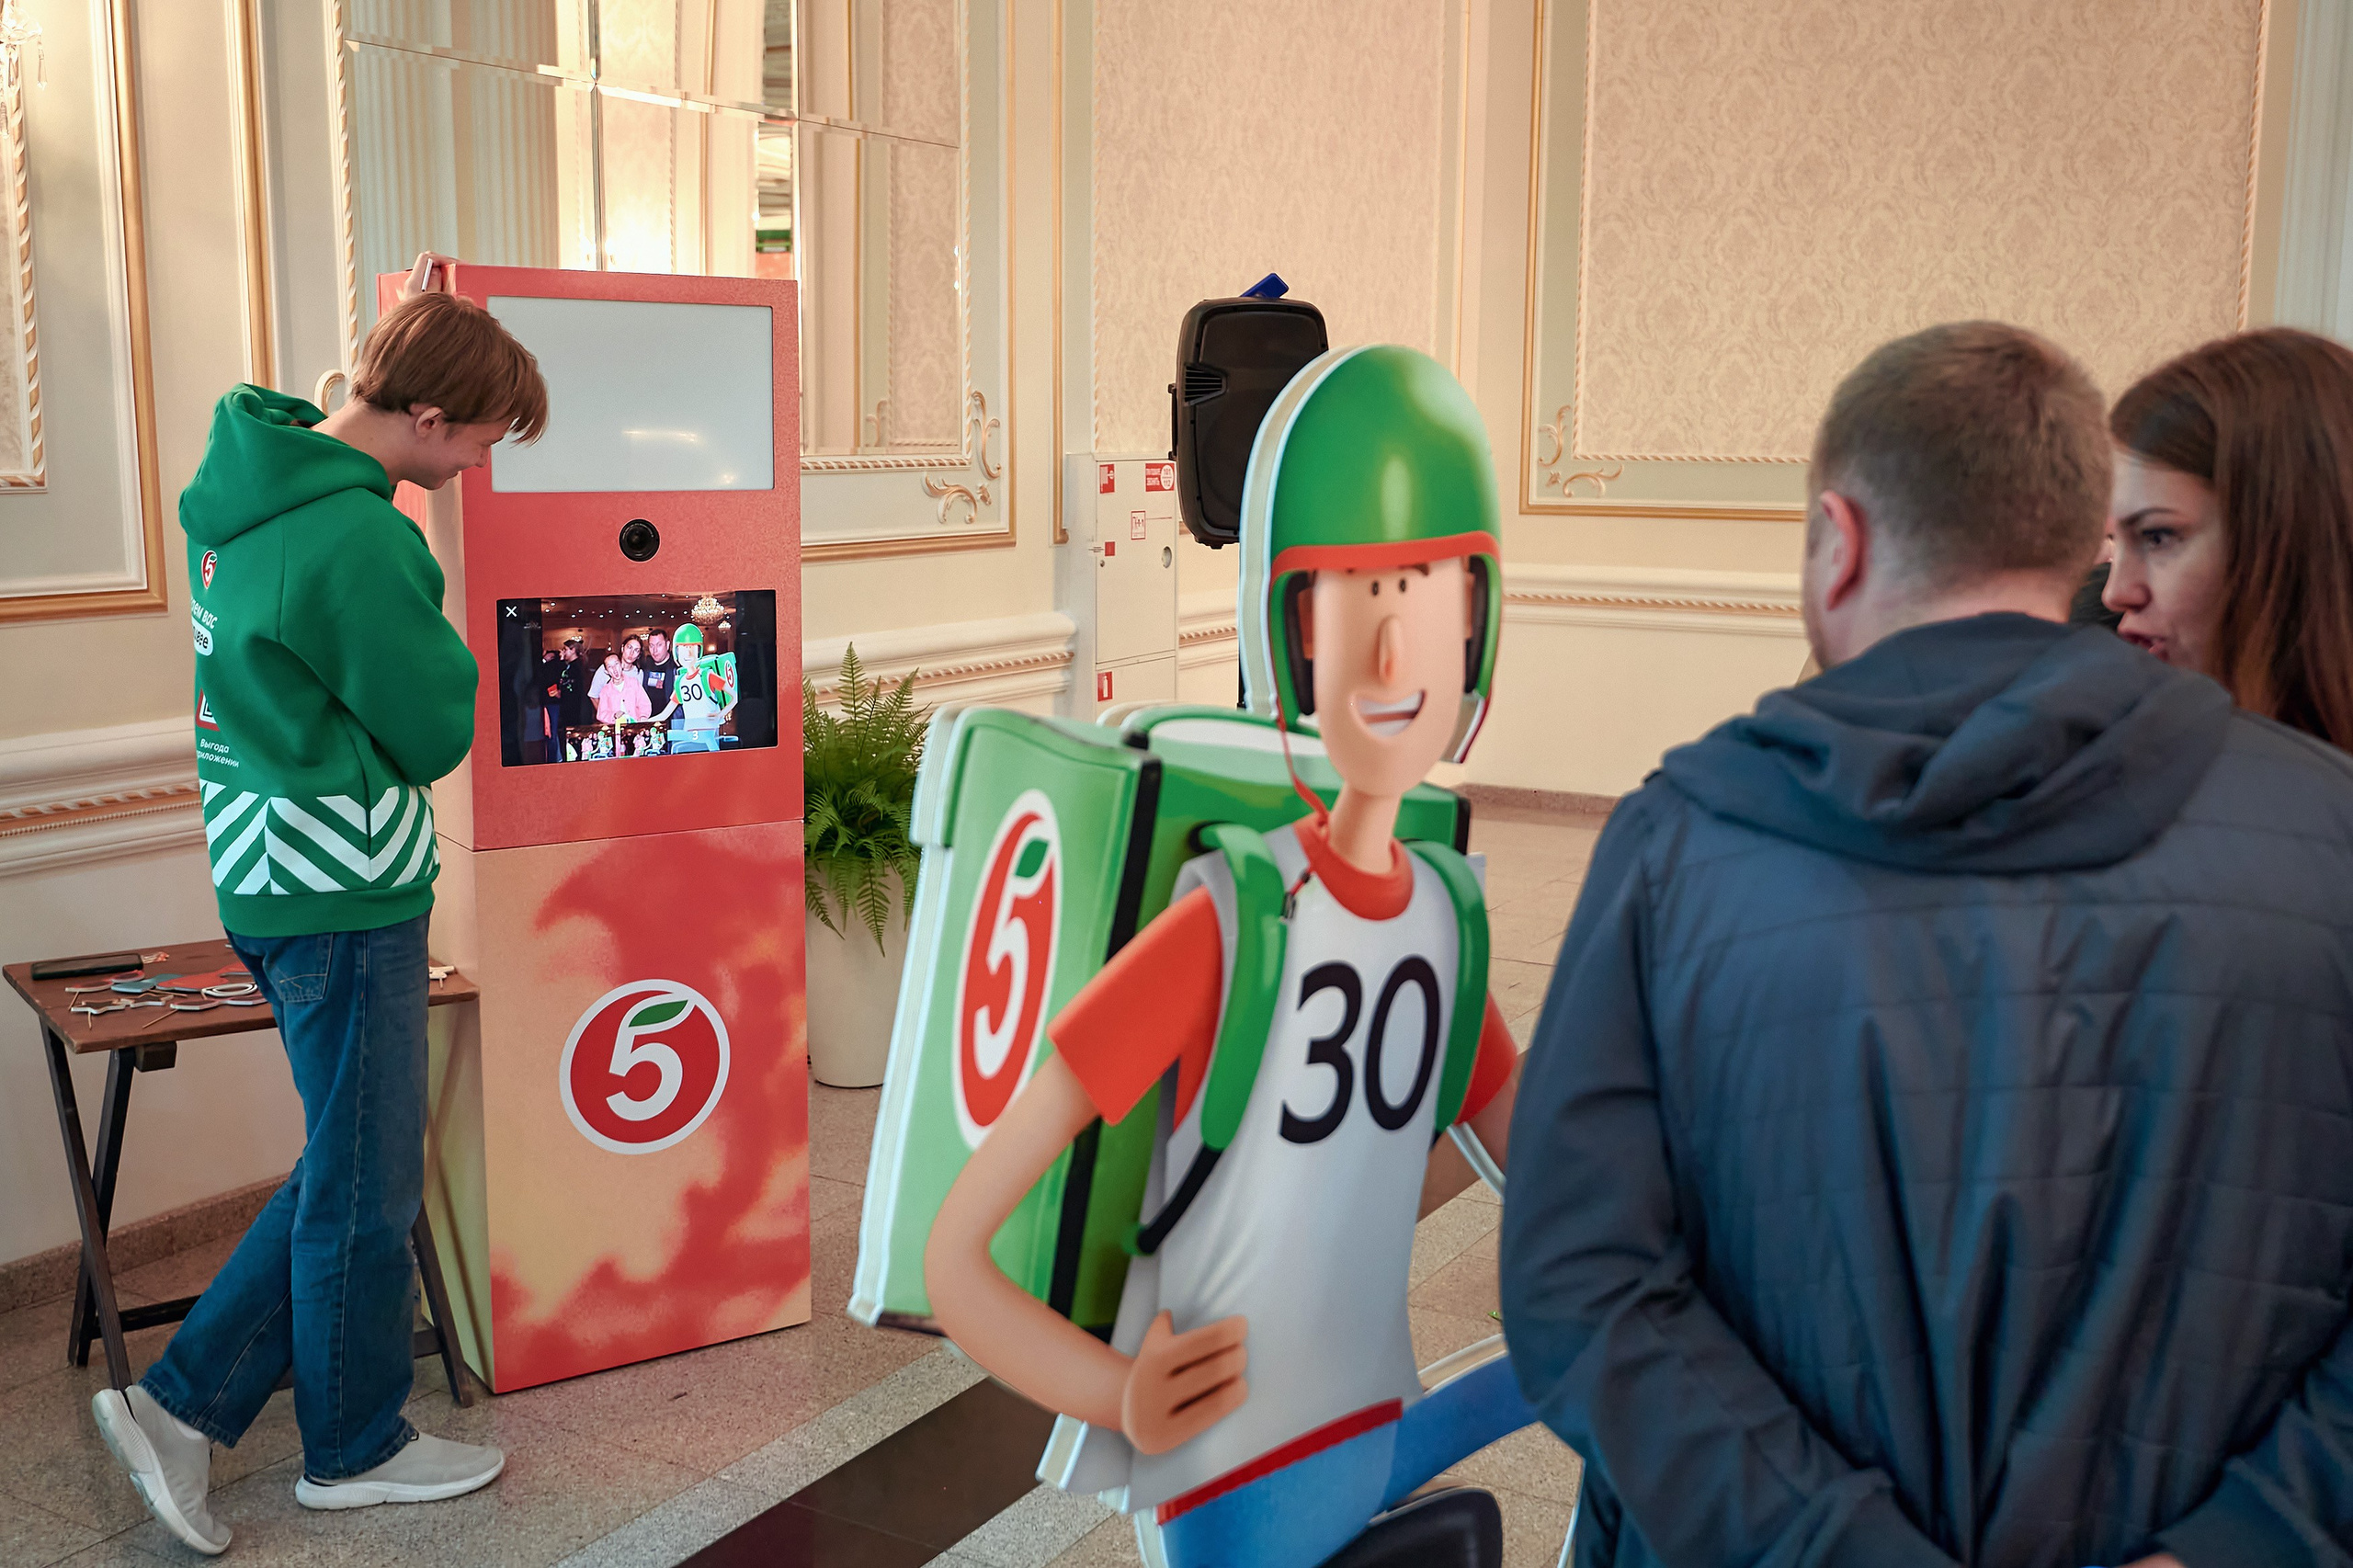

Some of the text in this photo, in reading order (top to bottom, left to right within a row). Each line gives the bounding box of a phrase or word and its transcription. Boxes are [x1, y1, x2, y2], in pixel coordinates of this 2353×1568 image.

[202, 610, 218, 630] вас
[680, 683, 702, 702] 30
[199, 738, 230, 754] Выгода
[605, 993, 697, 1122] 5
[1278, 953, 1441, 1145] 30
